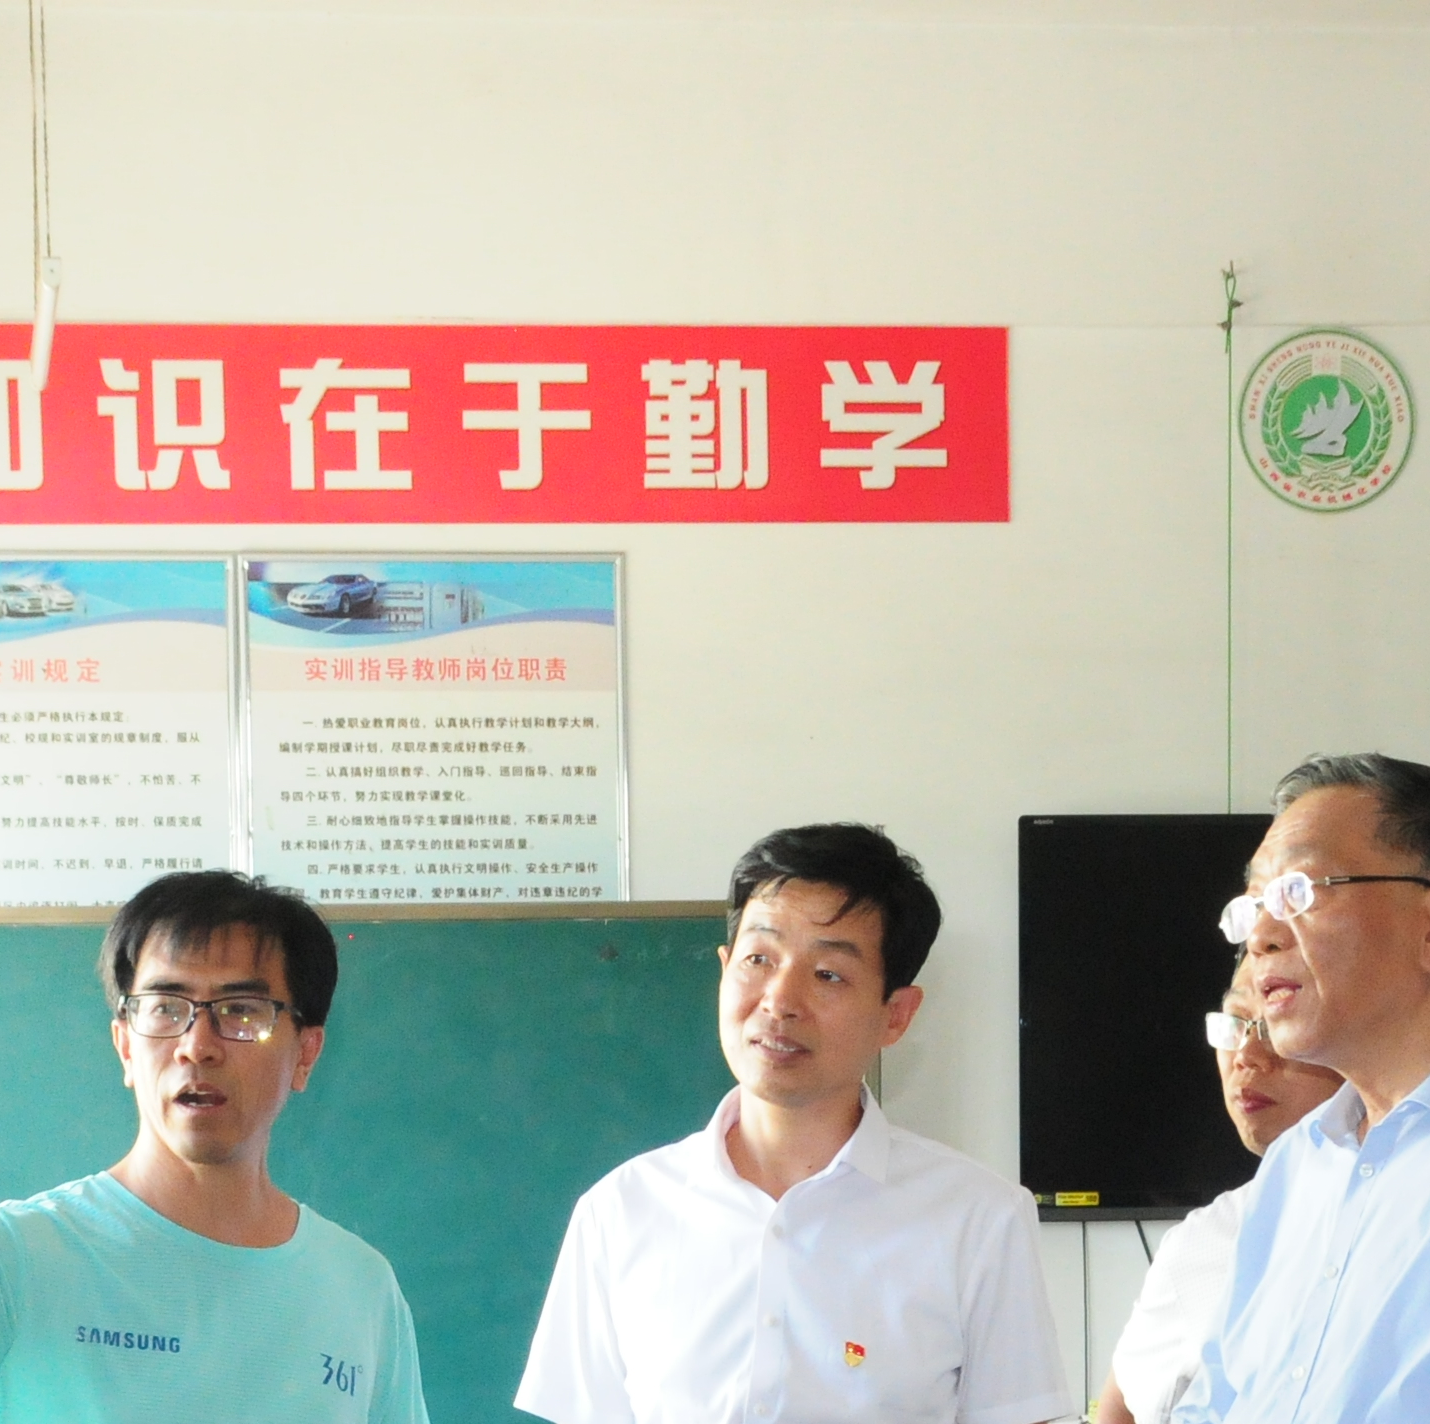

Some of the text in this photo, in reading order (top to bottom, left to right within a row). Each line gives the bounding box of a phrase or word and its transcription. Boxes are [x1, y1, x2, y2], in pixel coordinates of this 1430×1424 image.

[305, 657, 567, 682] 实训指导教师岗位职责
[76, 1326, 181, 1354] SAMSUNG
